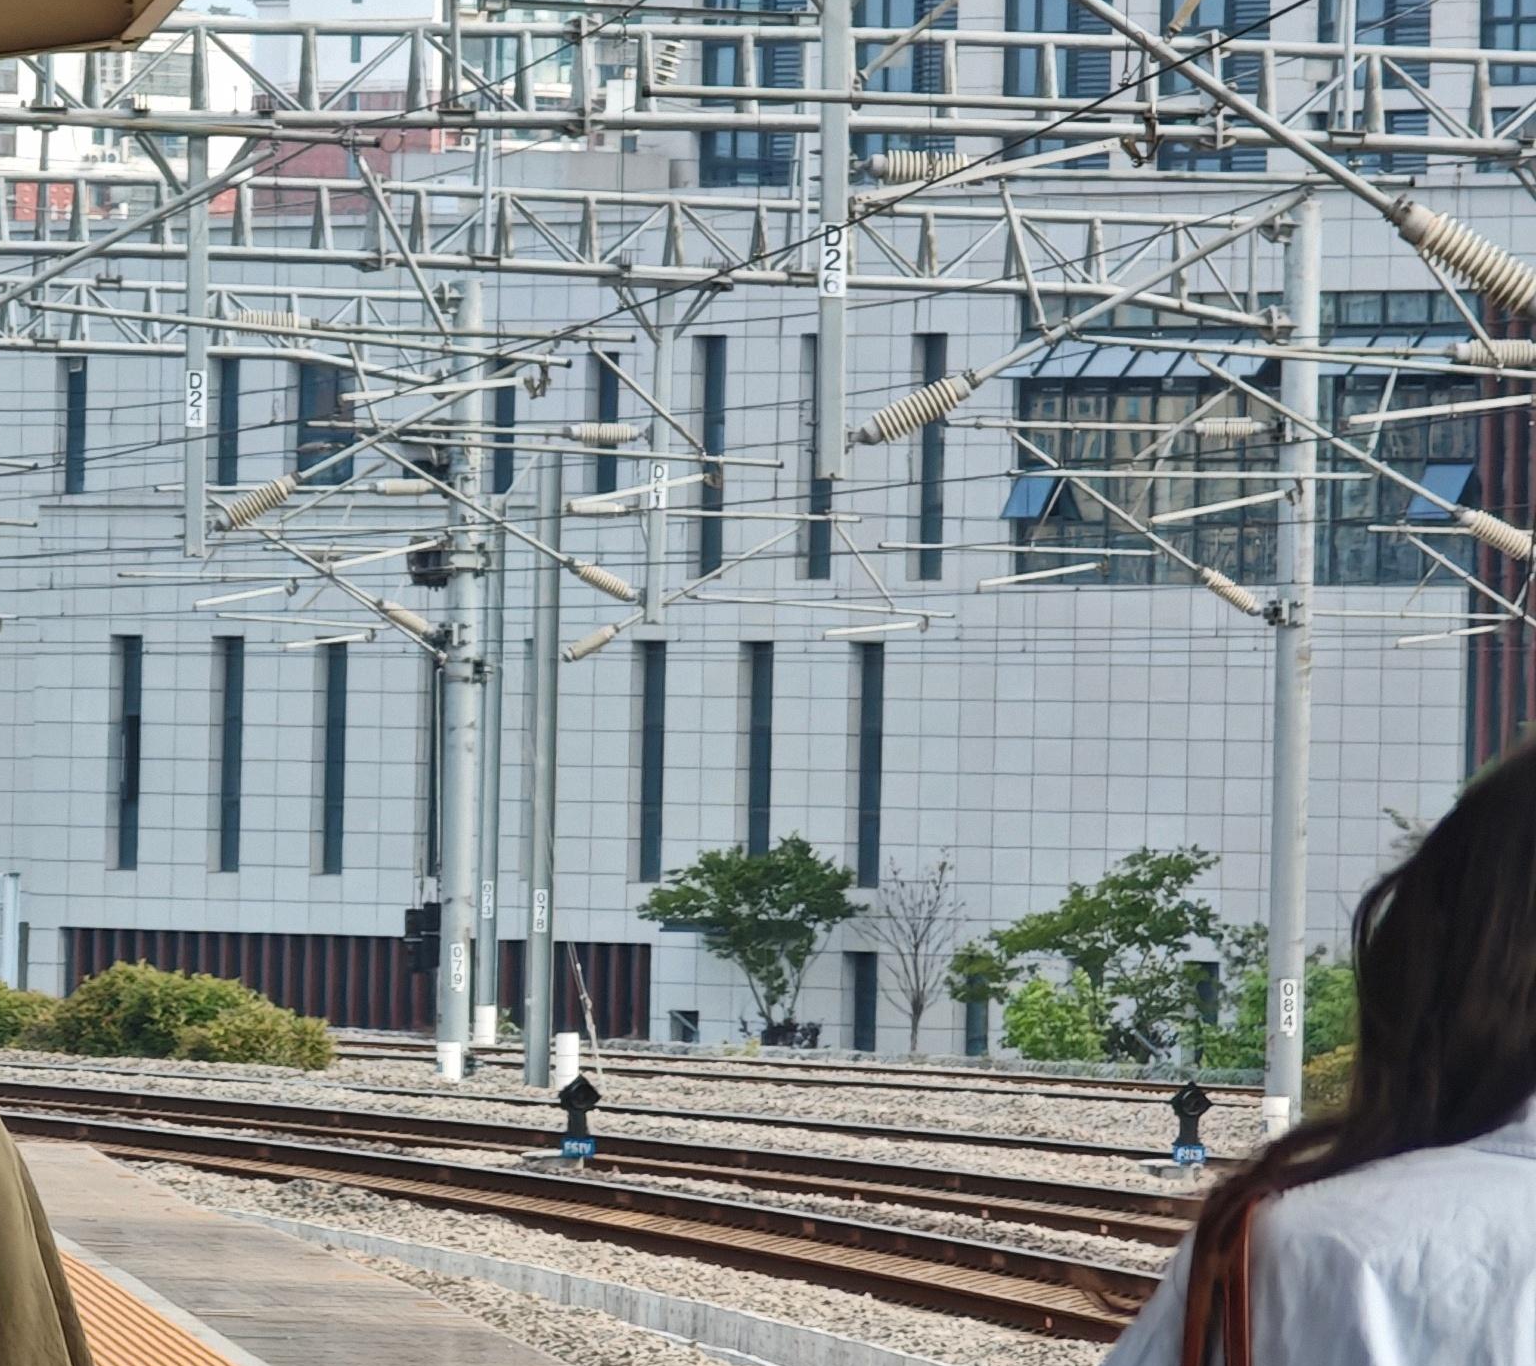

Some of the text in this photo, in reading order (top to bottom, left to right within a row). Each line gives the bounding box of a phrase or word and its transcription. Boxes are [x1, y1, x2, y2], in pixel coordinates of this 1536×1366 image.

[824, 225, 842, 294] D26
[190, 372, 202, 425] D24
[536, 892, 545, 930] 078
[453, 946, 463, 985] 079
[1283, 982, 1294, 1028] 084
